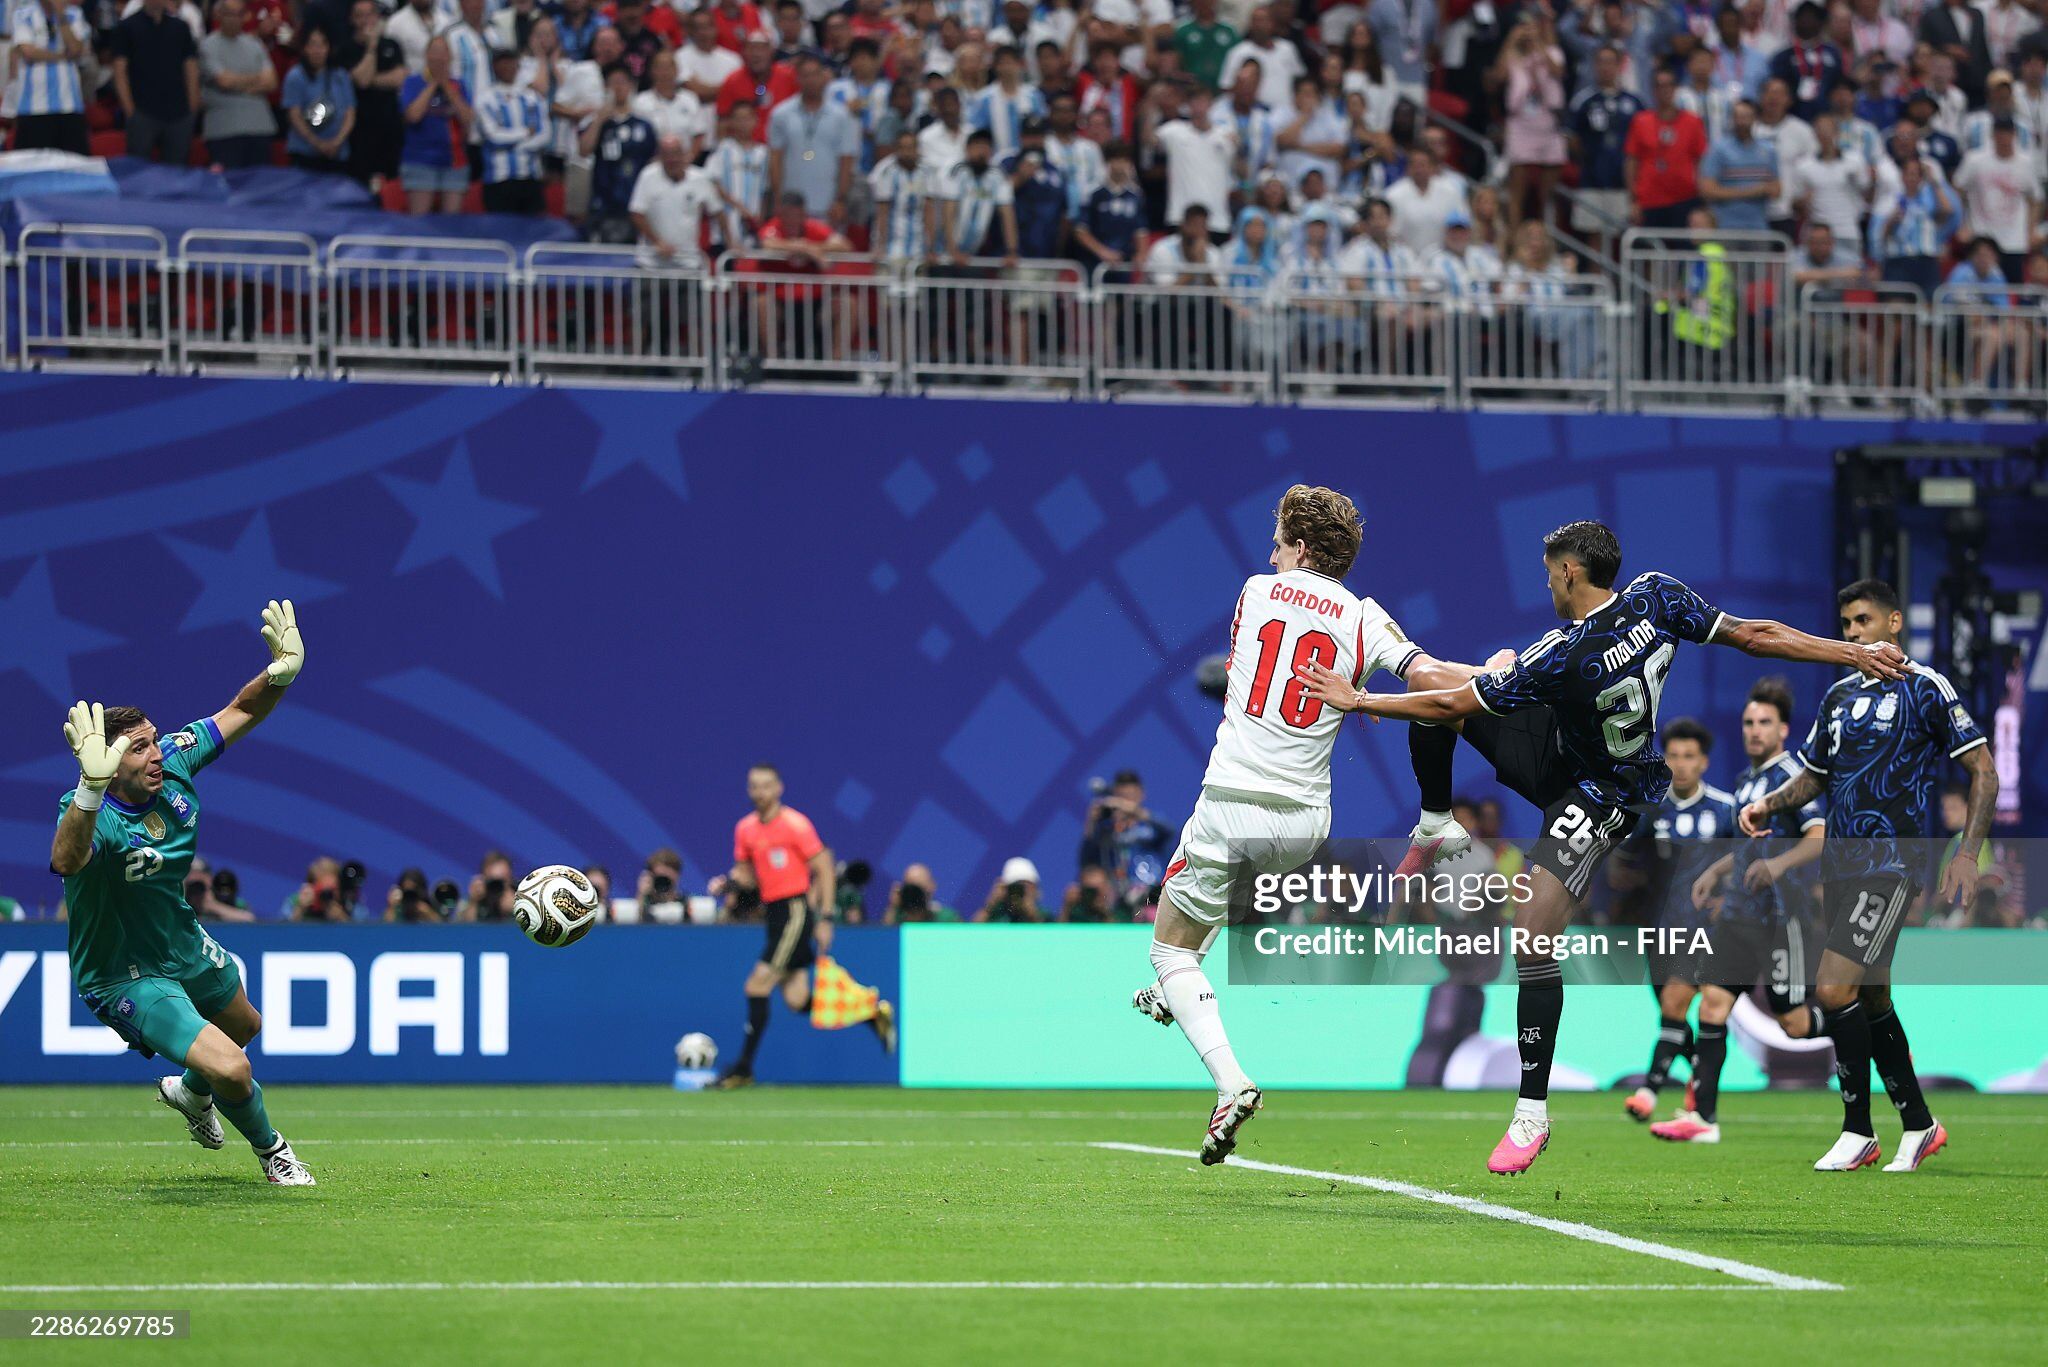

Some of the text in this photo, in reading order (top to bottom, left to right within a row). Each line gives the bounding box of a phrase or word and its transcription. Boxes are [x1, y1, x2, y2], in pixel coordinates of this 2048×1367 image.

[1269, 582, 1344, 619] GORDON
[1603, 618, 1657, 673] MOLINA
[1245, 618, 1338, 729] 18
[1549, 803, 1593, 855] 26
[125, 846, 164, 882] 23
[1849, 890, 1886, 932] 13
[1771, 948, 1789, 981] 3
